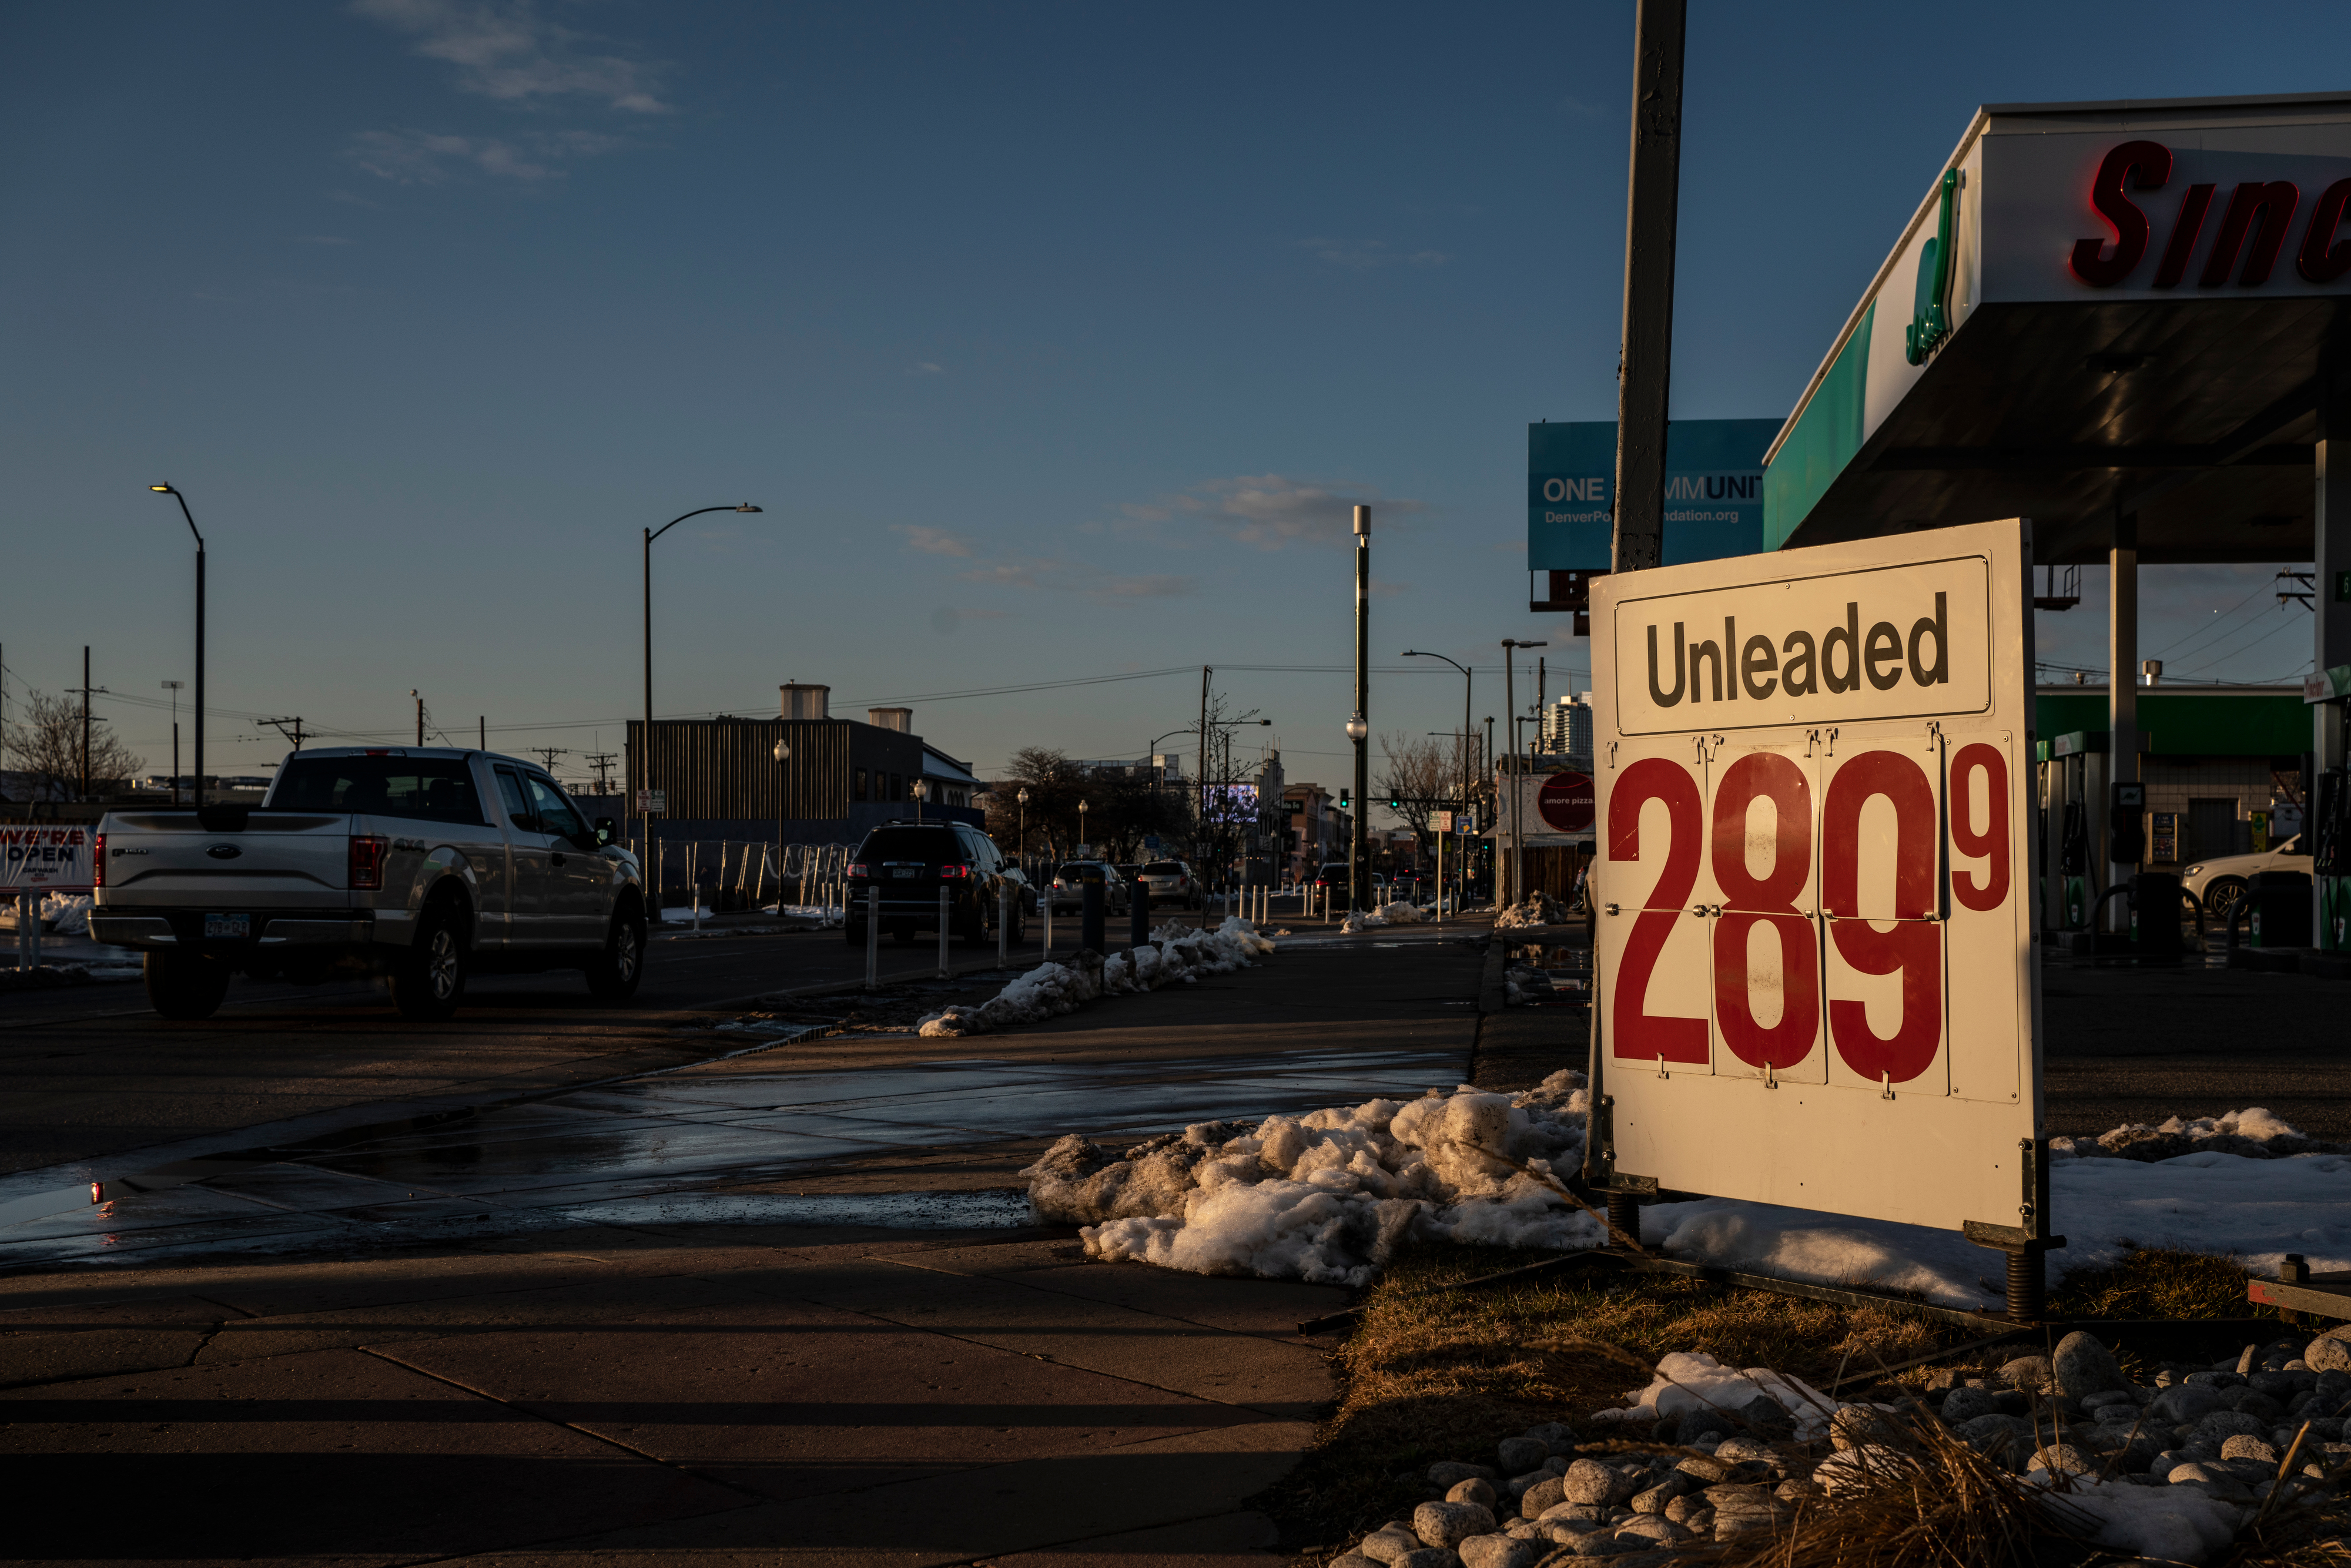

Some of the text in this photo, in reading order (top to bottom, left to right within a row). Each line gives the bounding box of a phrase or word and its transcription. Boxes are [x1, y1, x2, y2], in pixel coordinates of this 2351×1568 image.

[1543, 477, 1605, 502] ONE
[2344, 577, 2349, 594] 6
[1646, 591, 1949, 709] Unleaded
[0, 830, 84, 845] WE'RE
[8, 844, 74, 862] OPEN
[1607, 742, 2010, 1084] 289 9
